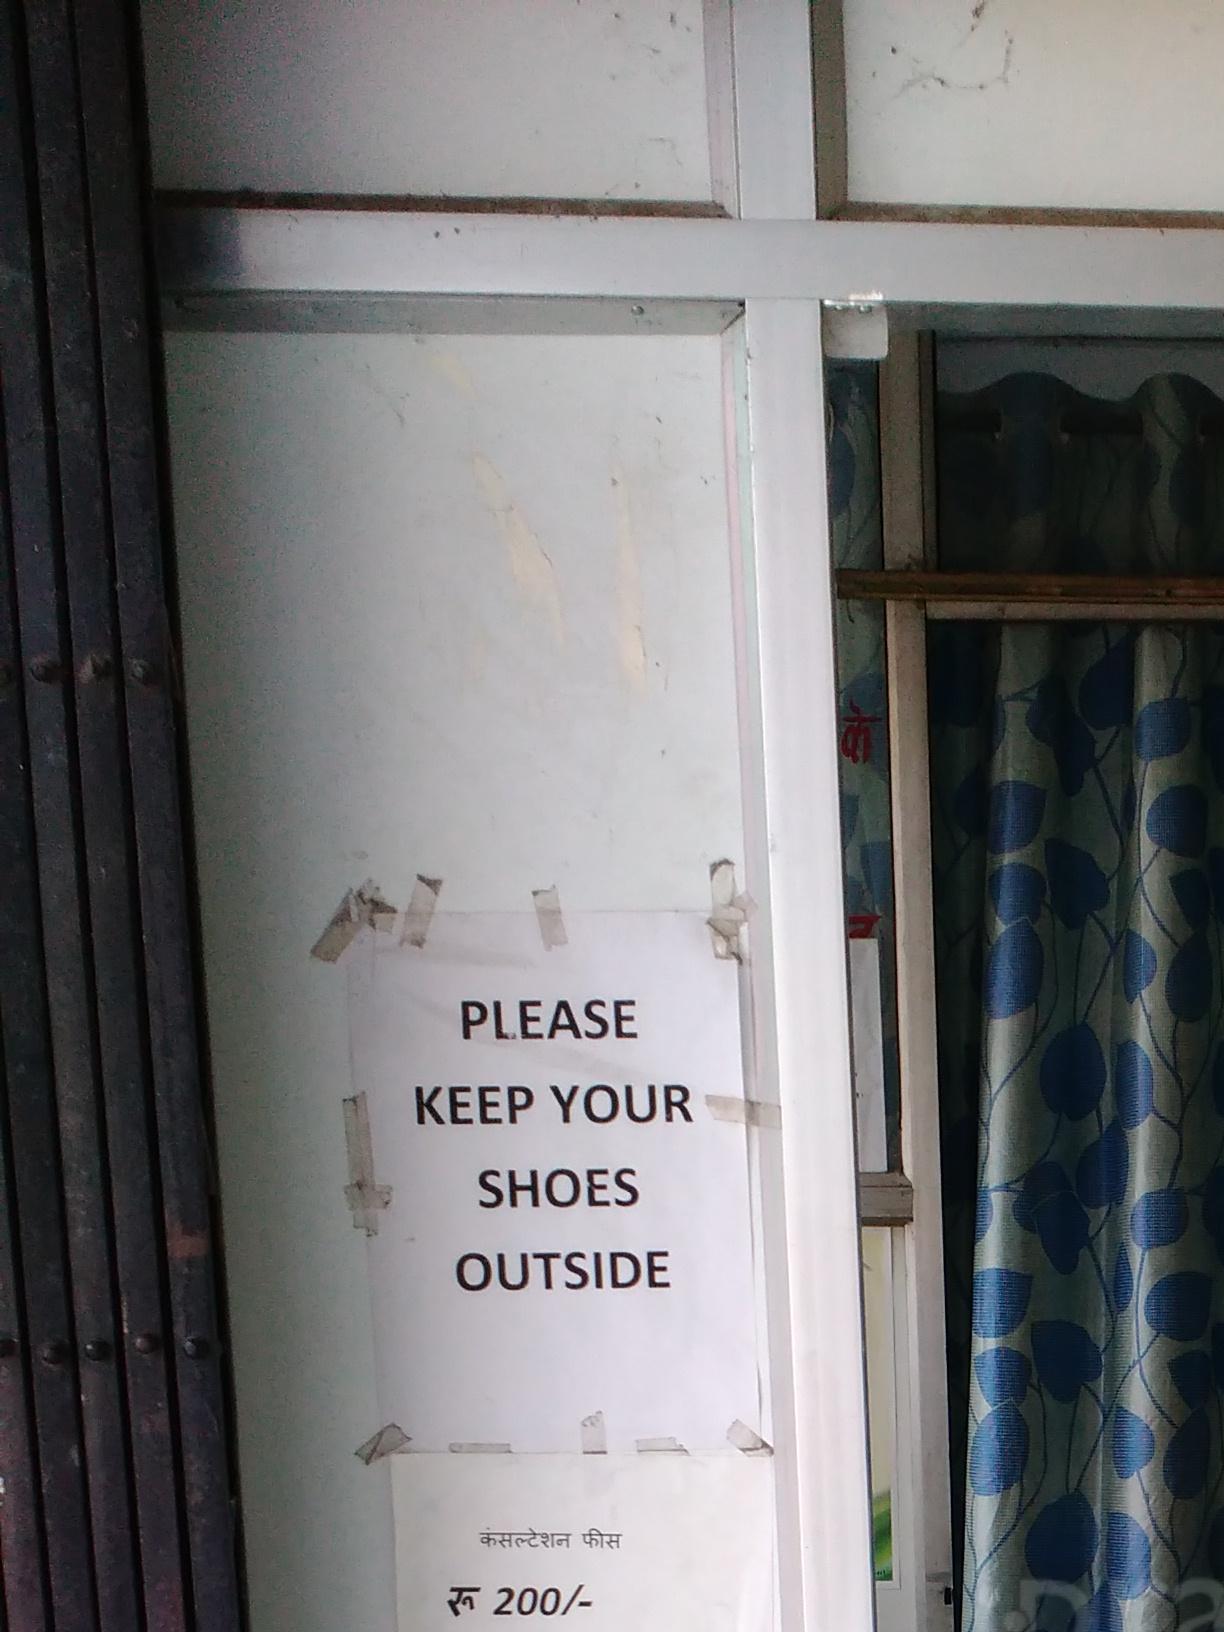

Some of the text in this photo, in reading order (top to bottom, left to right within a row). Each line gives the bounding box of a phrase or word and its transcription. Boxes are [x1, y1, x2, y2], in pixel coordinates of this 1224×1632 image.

[460, 999, 639, 1041] PLEASE
[414, 1083, 695, 1125] KEEP YOUR
[477, 1168, 640, 1209] SHOES
[455, 1250, 672, 1292] OUTSIDE
[480, 1527, 623, 1550] कंसल्टेशन फीस
[493, 1584, 593, 1616] 200/-
